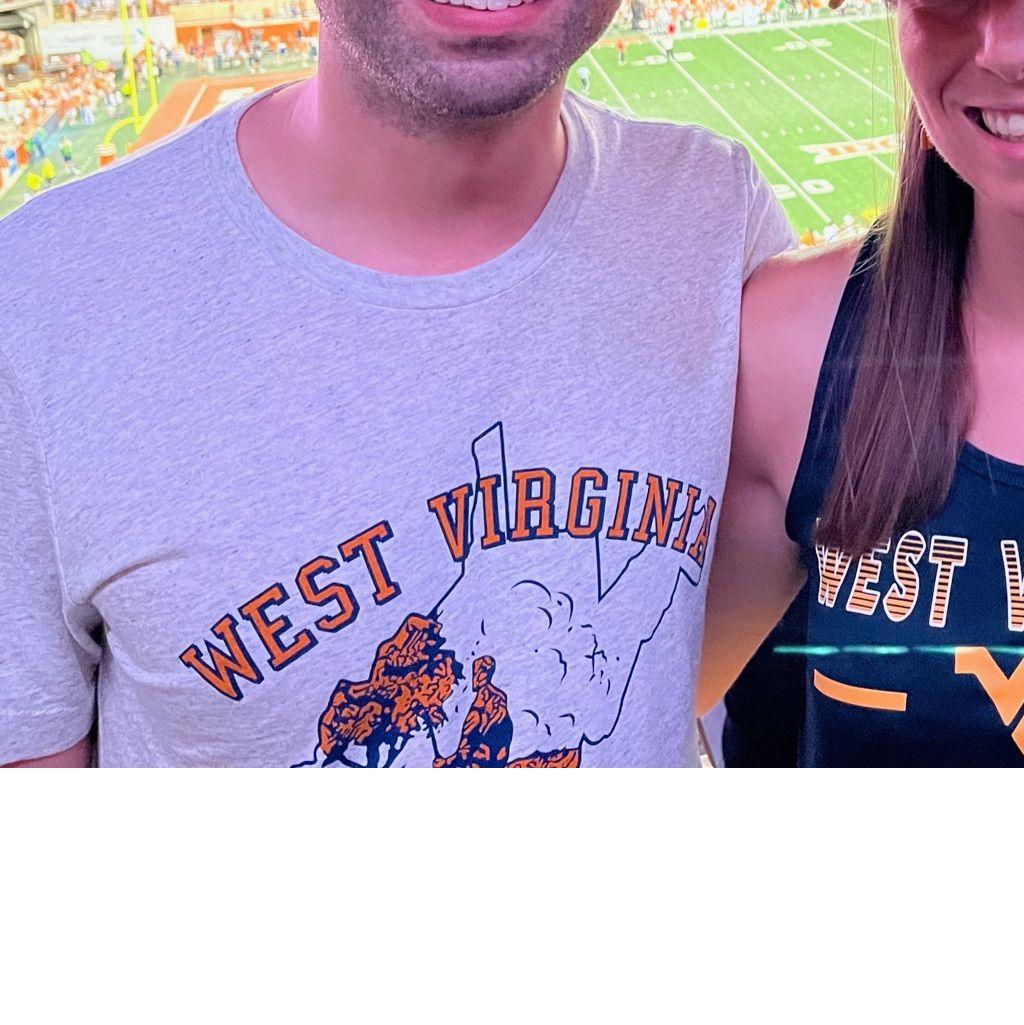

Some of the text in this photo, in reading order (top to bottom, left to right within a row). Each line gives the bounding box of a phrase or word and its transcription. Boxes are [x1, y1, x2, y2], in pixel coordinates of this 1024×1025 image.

[178, 466, 718, 703] WEST VIRGINIA
[815, 529, 969, 628] WEST
